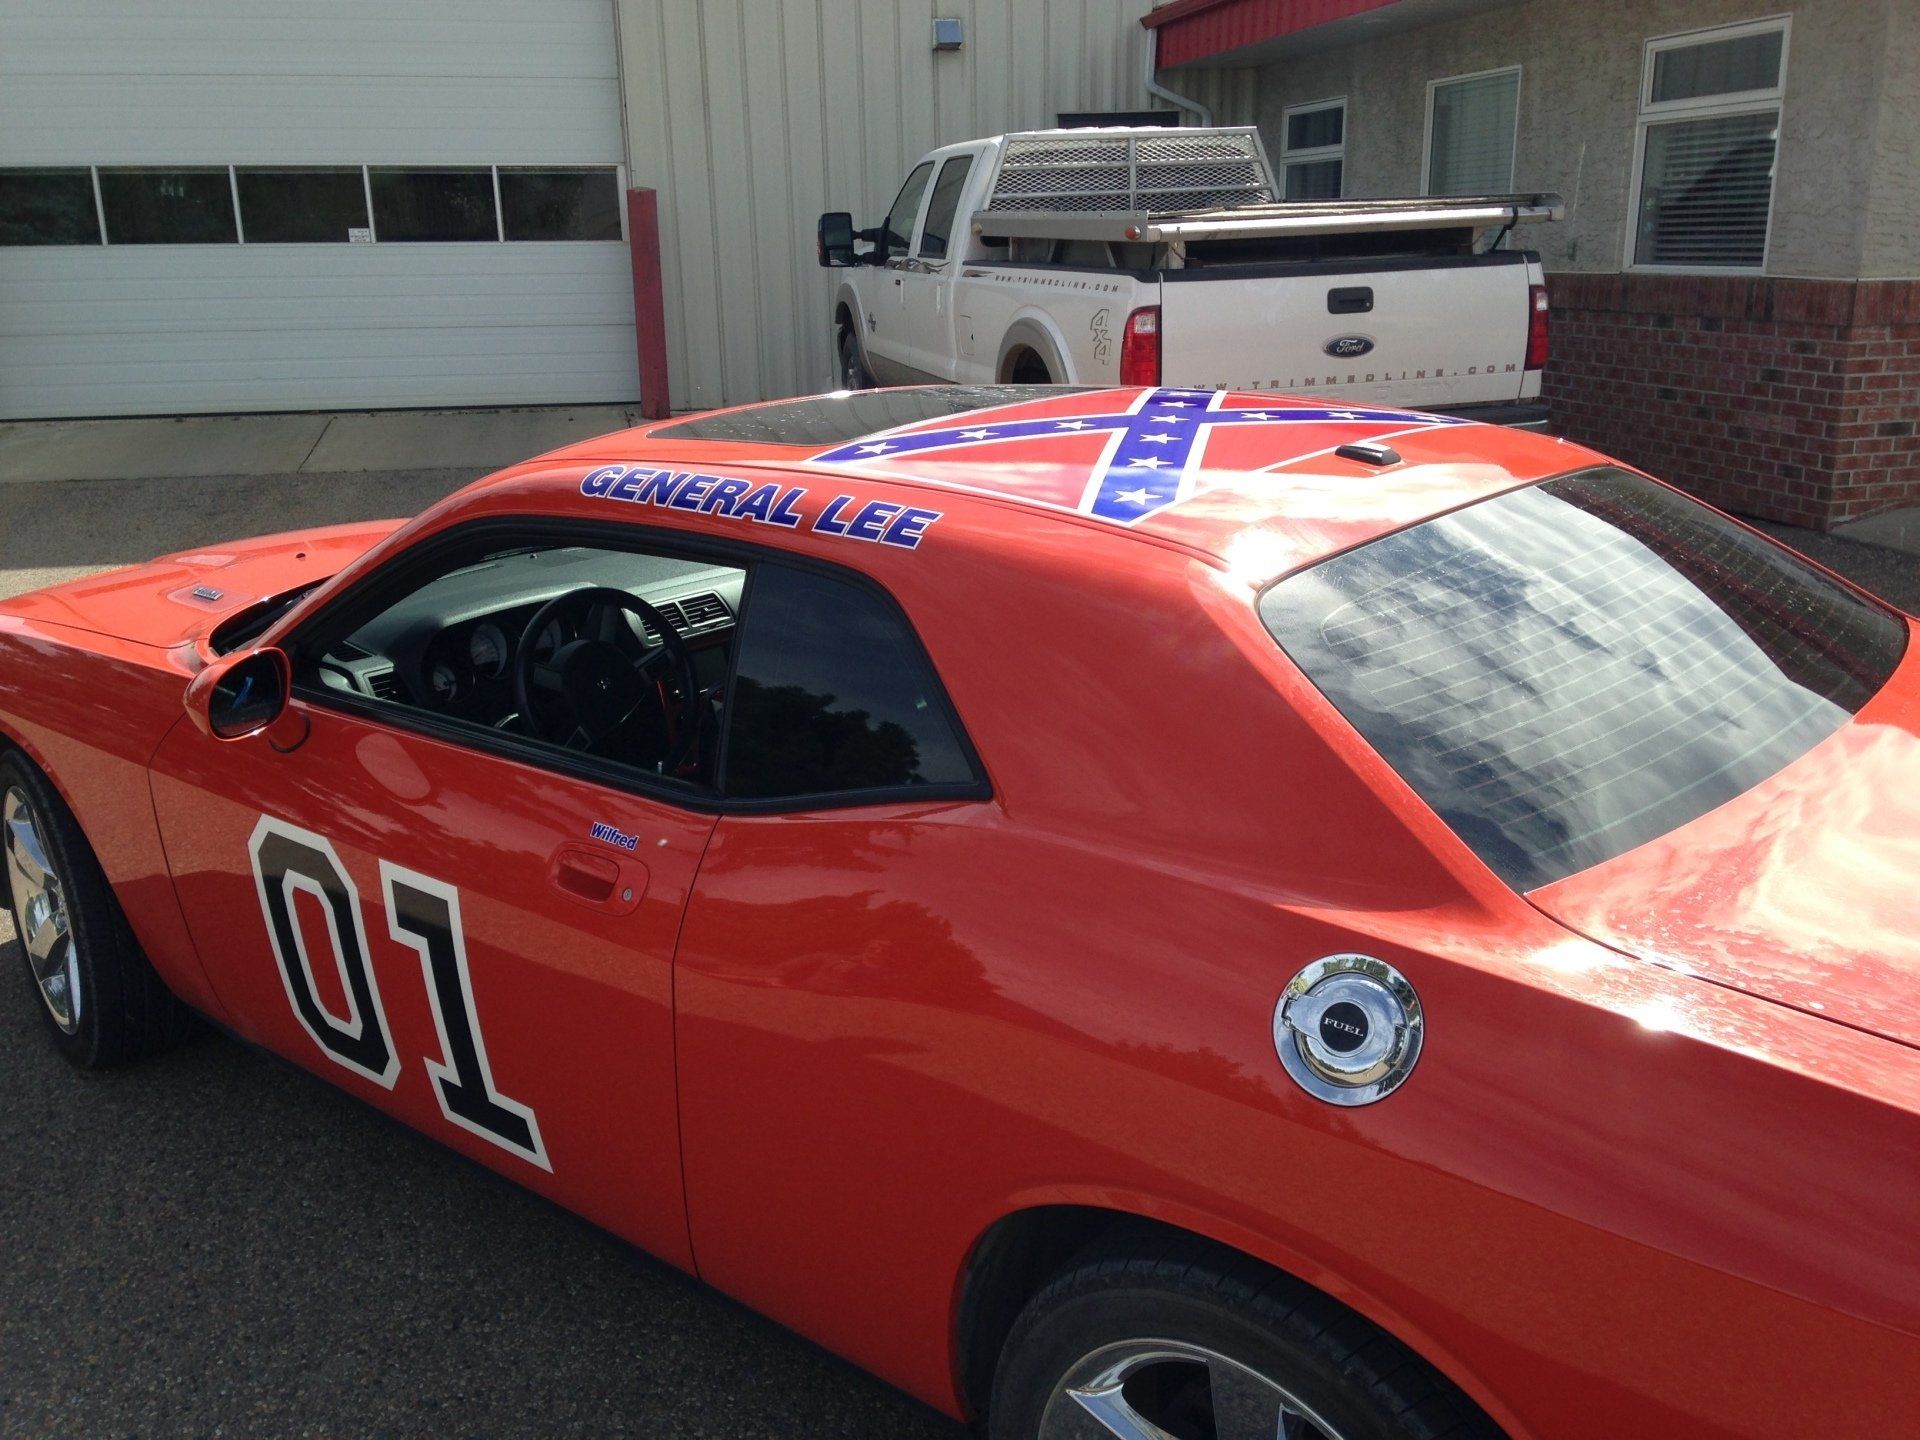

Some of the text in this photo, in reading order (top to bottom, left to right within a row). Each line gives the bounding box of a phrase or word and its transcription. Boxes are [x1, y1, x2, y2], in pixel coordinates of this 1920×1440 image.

[1336, 339, 1365, 353] Ford
[1179, 363, 1516, 391] WW.TRIMMEDLINE.COM
[580, 465, 944, 550] GENERAL LEE
[590, 821, 640, 851] Wilfred
[247, 813, 554, 1174] 01
[1323, 1017, 1364, 1037] FUEL
